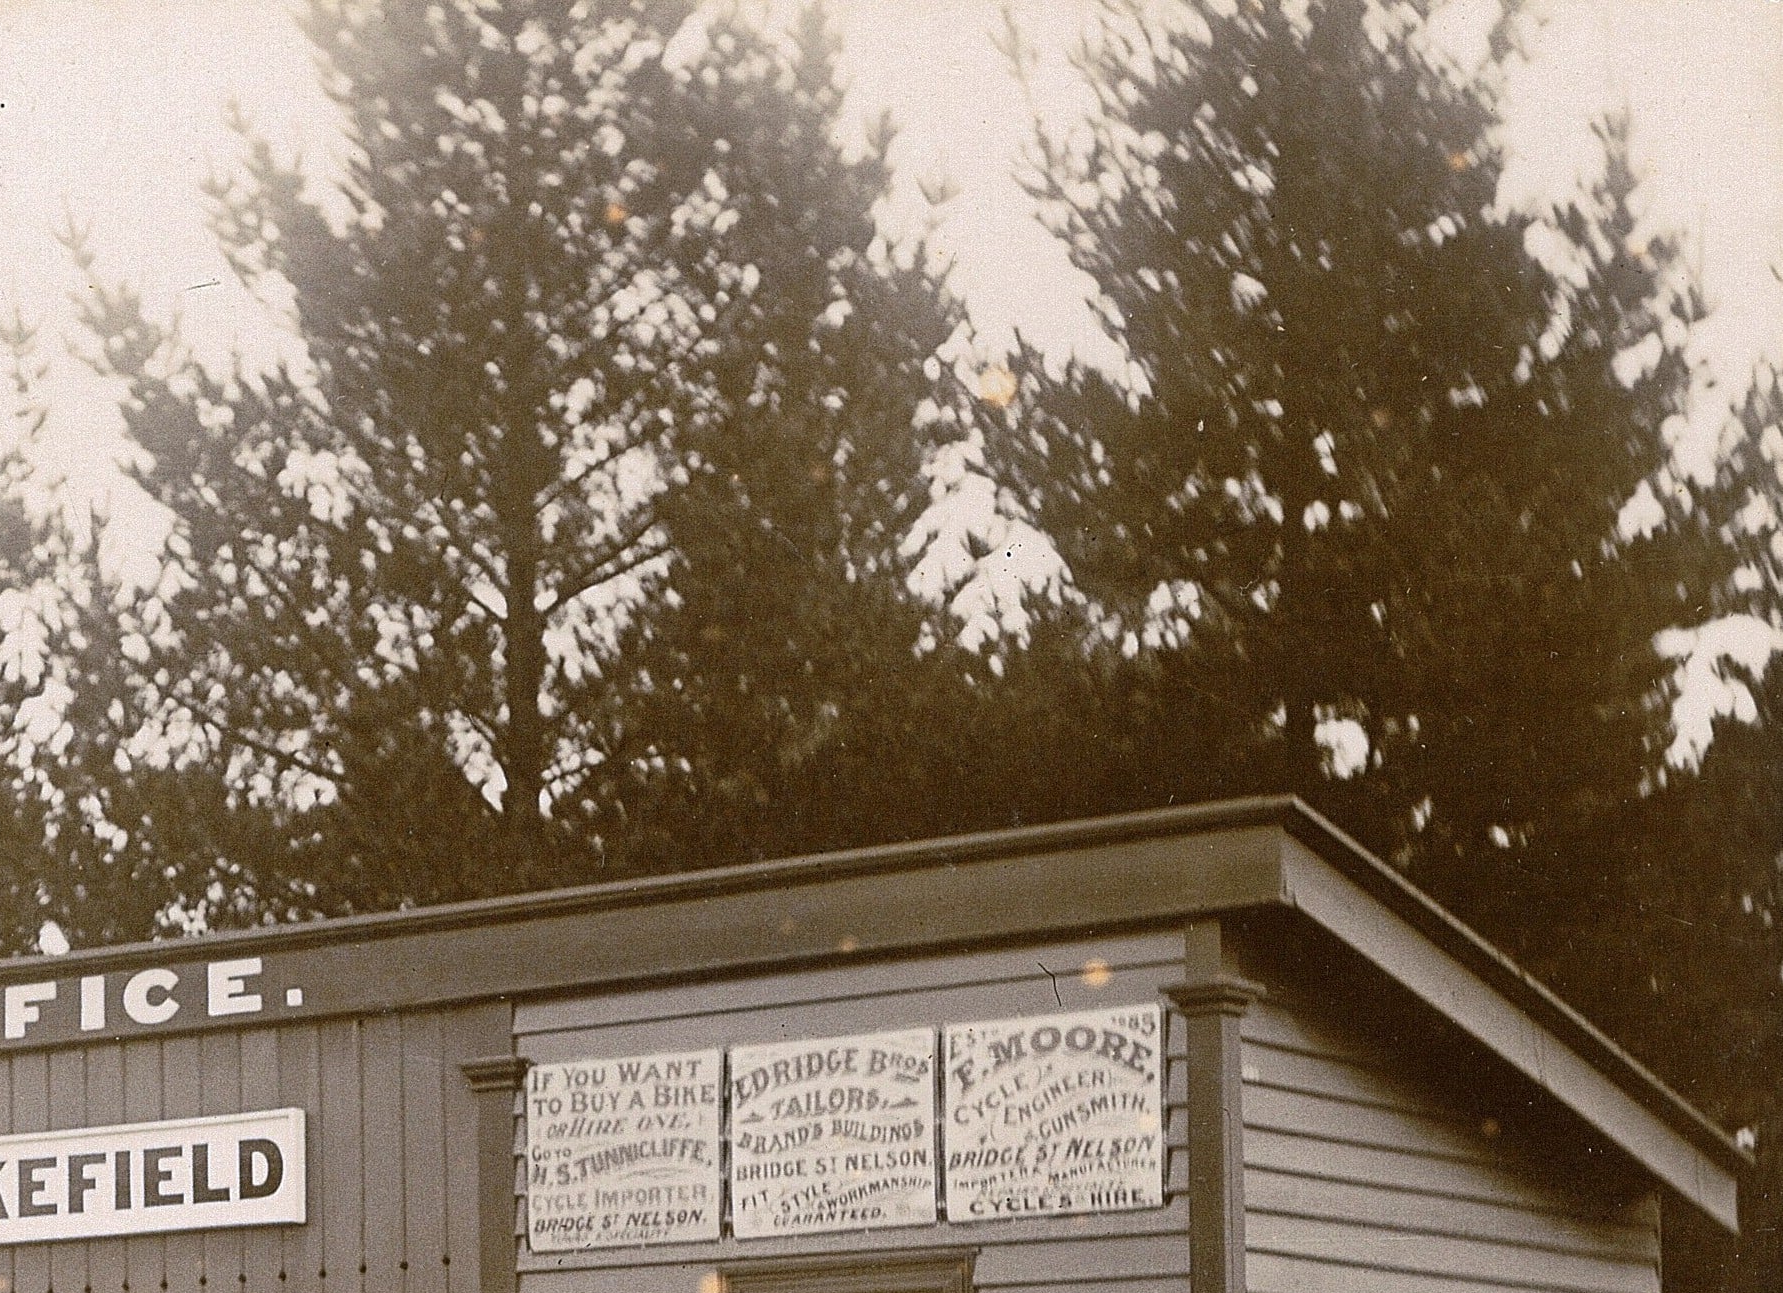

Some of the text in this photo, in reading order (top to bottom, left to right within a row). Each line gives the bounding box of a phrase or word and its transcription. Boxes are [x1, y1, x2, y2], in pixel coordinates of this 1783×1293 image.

[533, 1059, 702, 1093] IF YOU WANT
[533, 1084, 715, 1118] TO BUY A BIKE
[953, 1072, 1028, 1126] CYCLE
[1004, 1069, 1106, 1126] ENGINEER
[569, 1116, 628, 1139] HIRE
[949, 1144, 1027, 1172] BRIDGE
[1065, 1134, 1156, 1162] NELSON
[736, 1159, 807, 1181] BRIDGE
[532, 1192, 587, 1212] CYCLE
[780, 1182, 830, 1213] STYLE
[825, 1176, 932, 1209] WORKMANSHIP
[534, 1216, 594, 1233] BRIDGE
